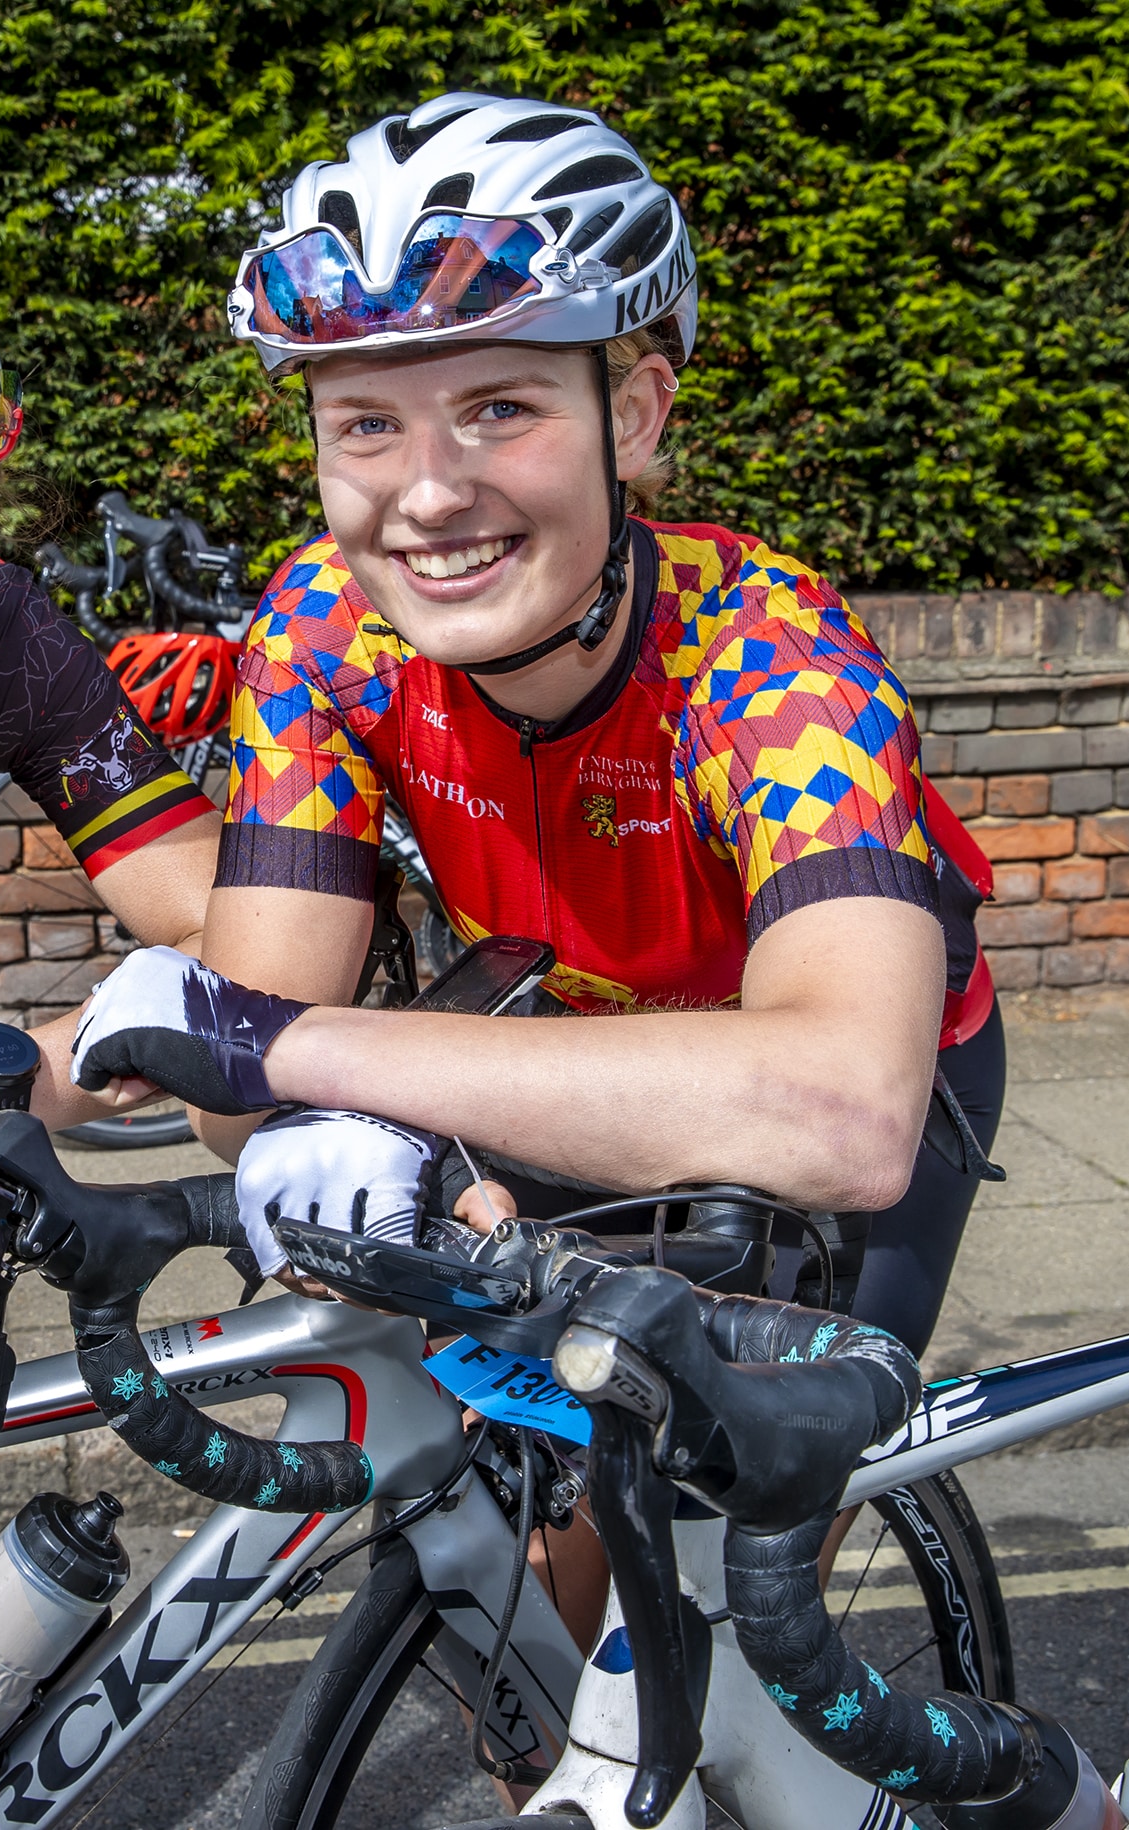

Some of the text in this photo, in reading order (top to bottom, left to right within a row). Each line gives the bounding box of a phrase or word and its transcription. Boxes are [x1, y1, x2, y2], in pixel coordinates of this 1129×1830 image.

[421, 703, 454, 731] TAC
[617, 817, 673, 837] SPORT
[339, 1113, 424, 1155] ALTURA
[458, 1344, 501, 1365] F
